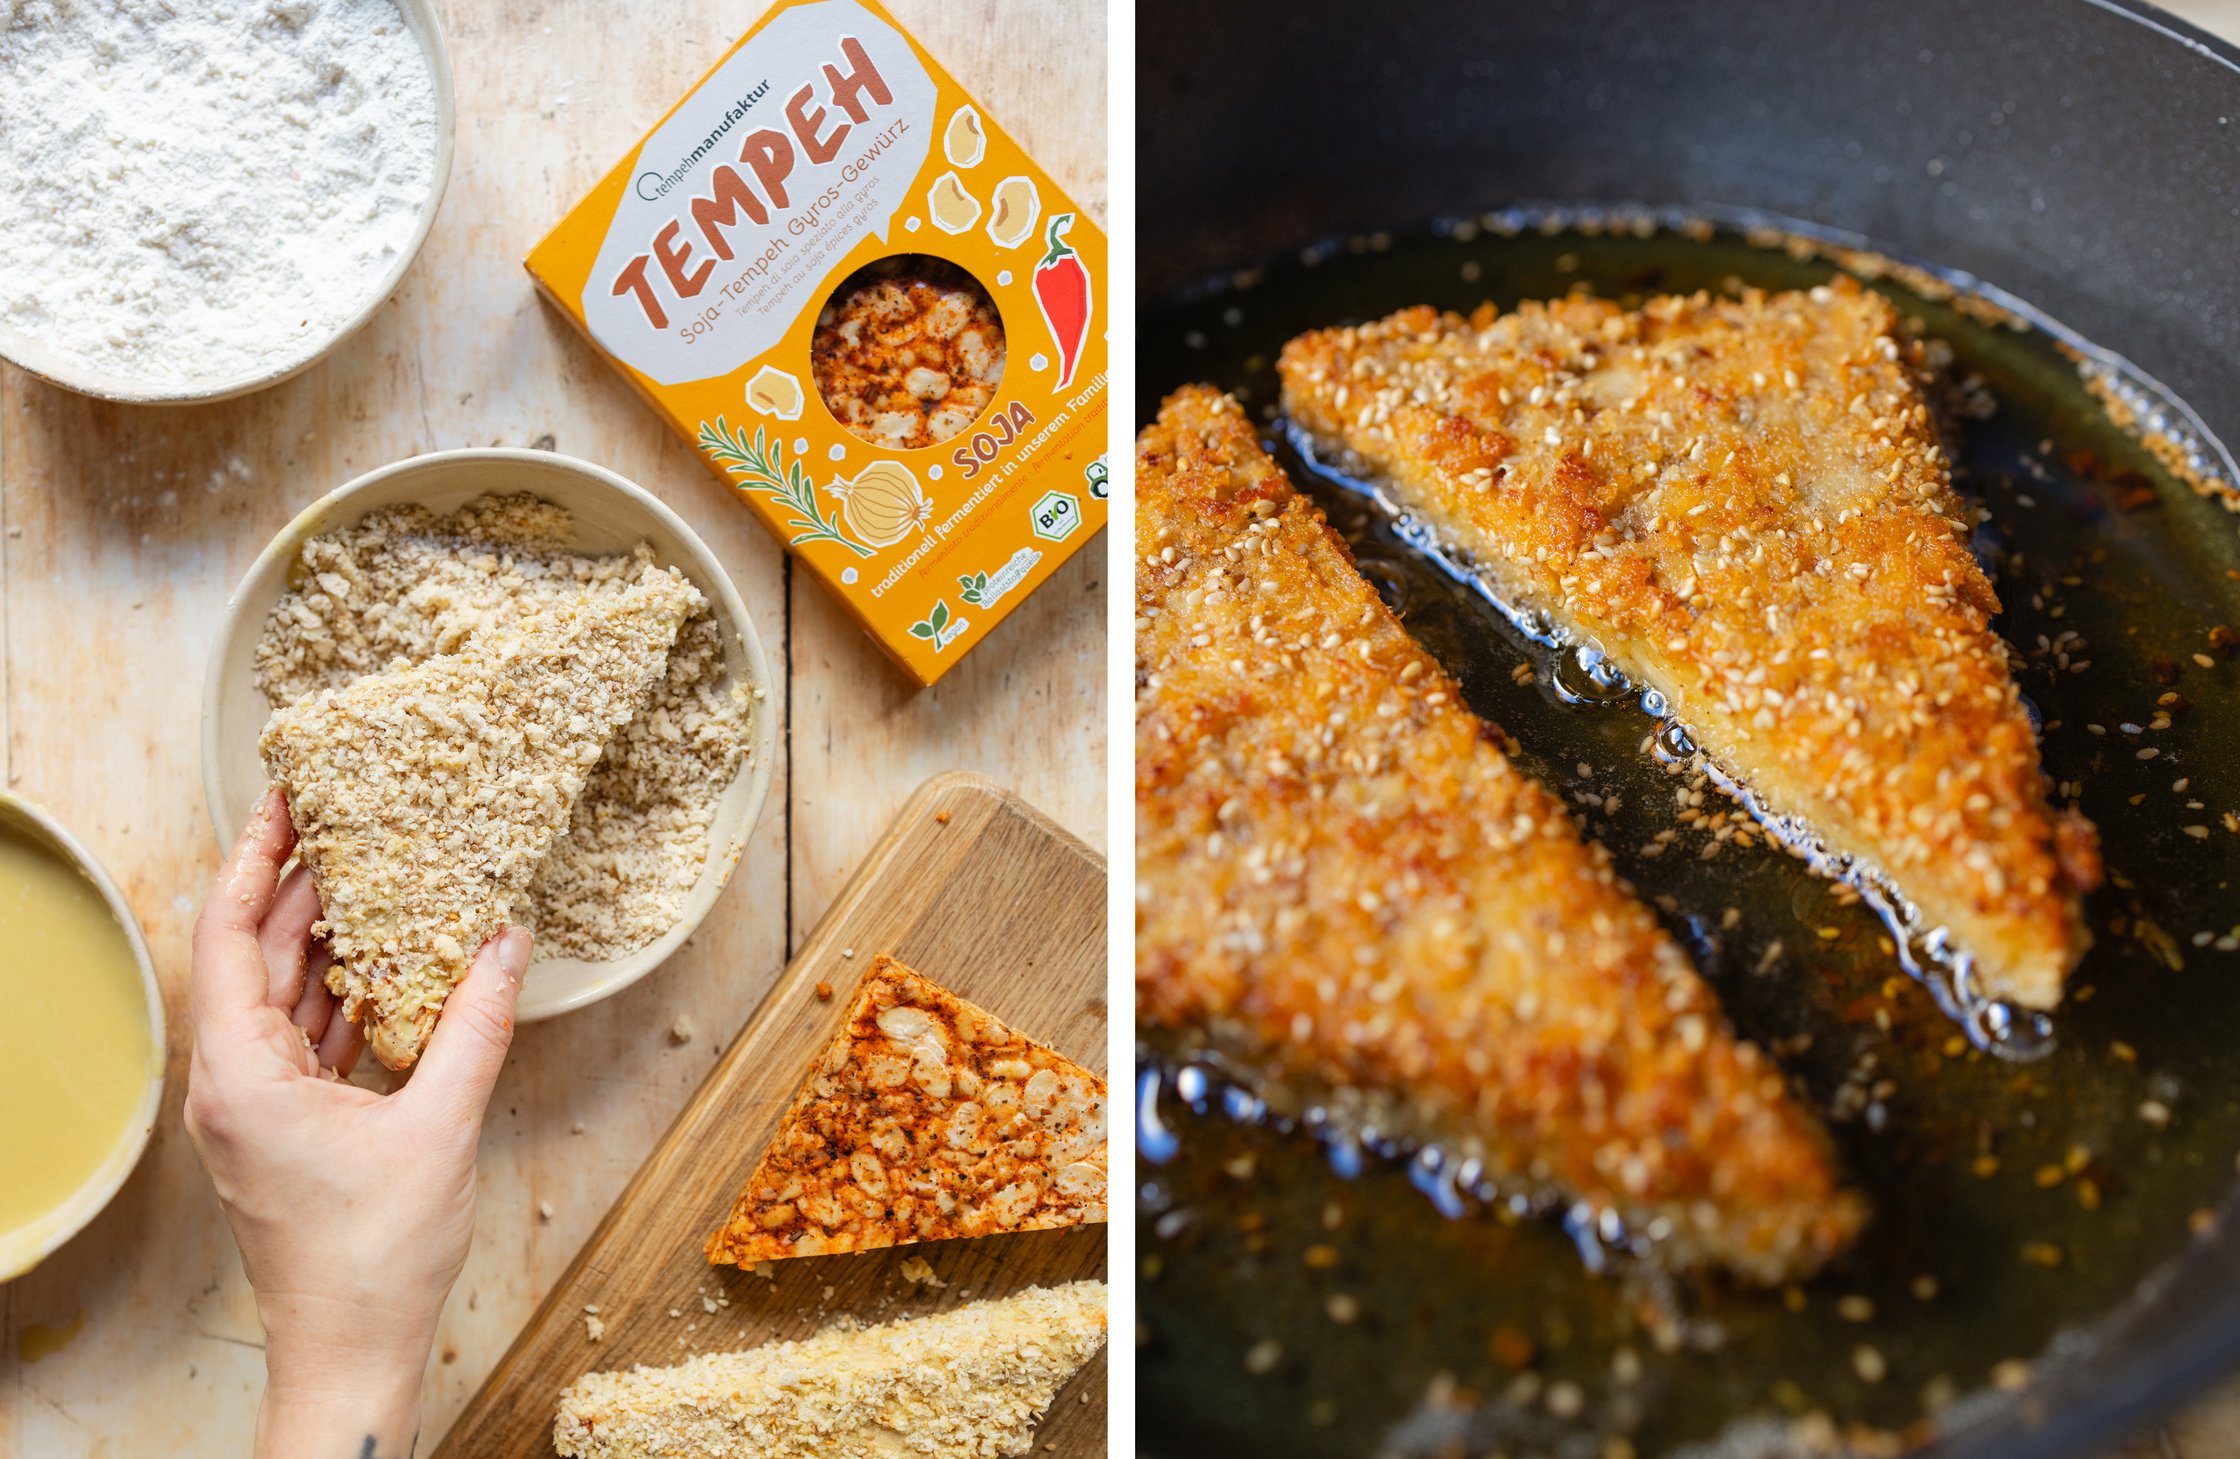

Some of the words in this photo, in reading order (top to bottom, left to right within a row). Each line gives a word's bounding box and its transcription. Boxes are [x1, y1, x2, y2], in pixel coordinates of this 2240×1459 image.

[611, 36, 894, 330] TEMPEH
[655, 78, 771, 197] tempehmanufaktur
[787, 117, 910, 236] Gyros-Gewürz
[680, 238, 790, 345] Soja-Tempeh
[736, 281, 771, 318] Tempeh
[836, 200, 856, 220] alla
[854, 174, 881, 204] gyros
[757, 281, 793, 317] Tempeh
[825, 223, 854, 252] épices
[853, 198, 879, 227] gyros
[952, 401, 1036, 477] SOJA
[870, 533, 938, 597] traditionell
[934, 474, 1003, 541] fermentiert
[999, 461, 1018, 477] in
[1015, 411, 1070, 462] unserem
[943, 620, 966, 642] vegan
